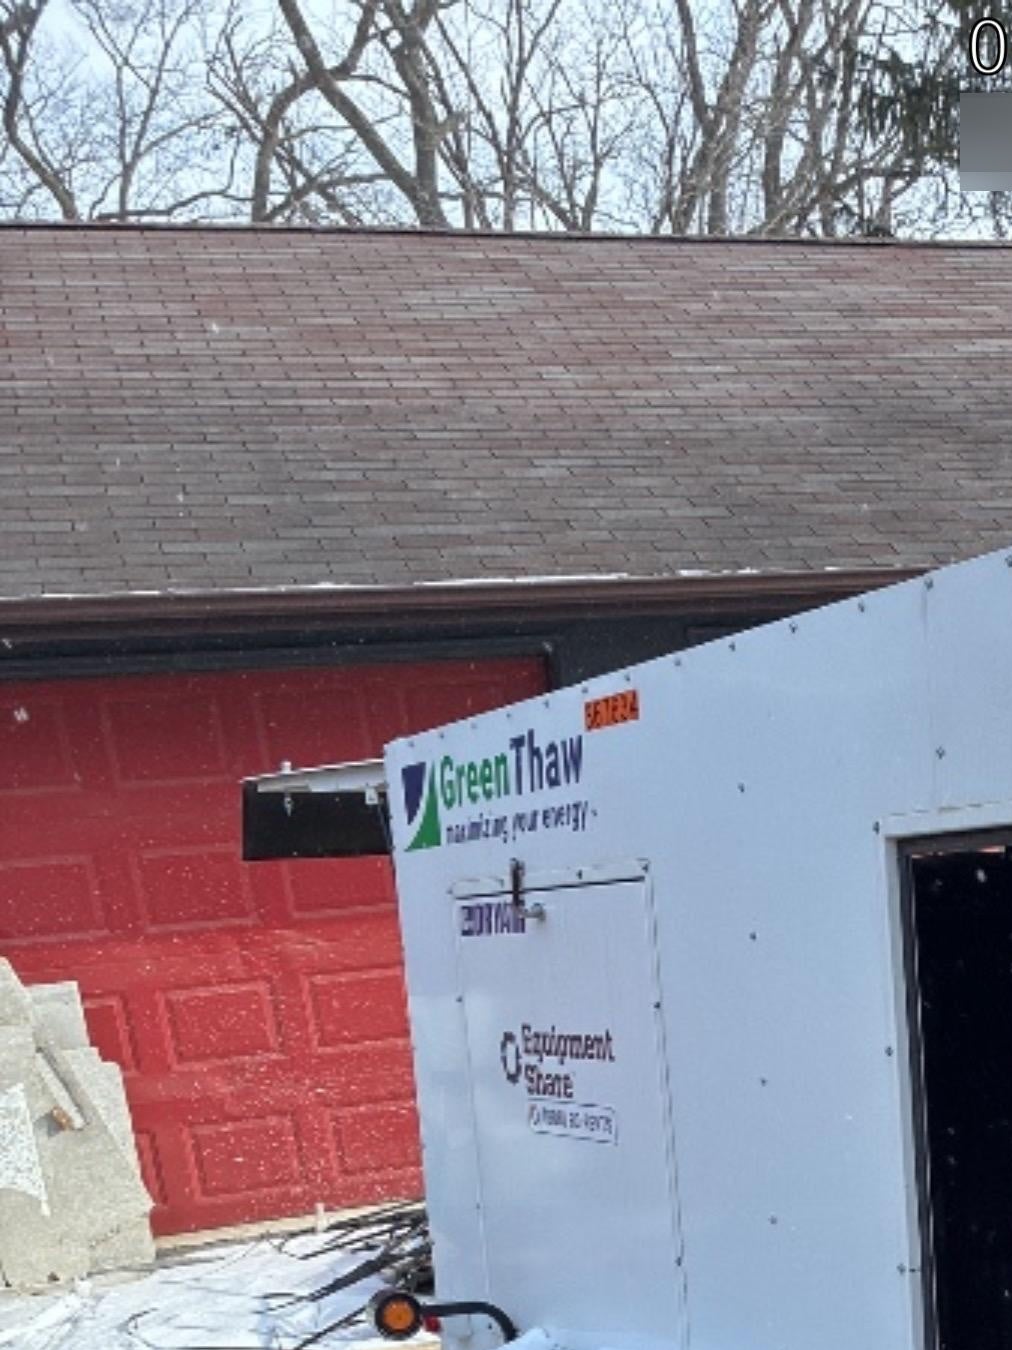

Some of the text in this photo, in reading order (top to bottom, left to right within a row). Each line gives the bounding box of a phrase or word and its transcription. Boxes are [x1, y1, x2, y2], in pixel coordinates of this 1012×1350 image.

[440, 728, 583, 811] GreenThaw
[521, 1022, 616, 1066] Equipment
[524, 1064, 574, 1099] Share
